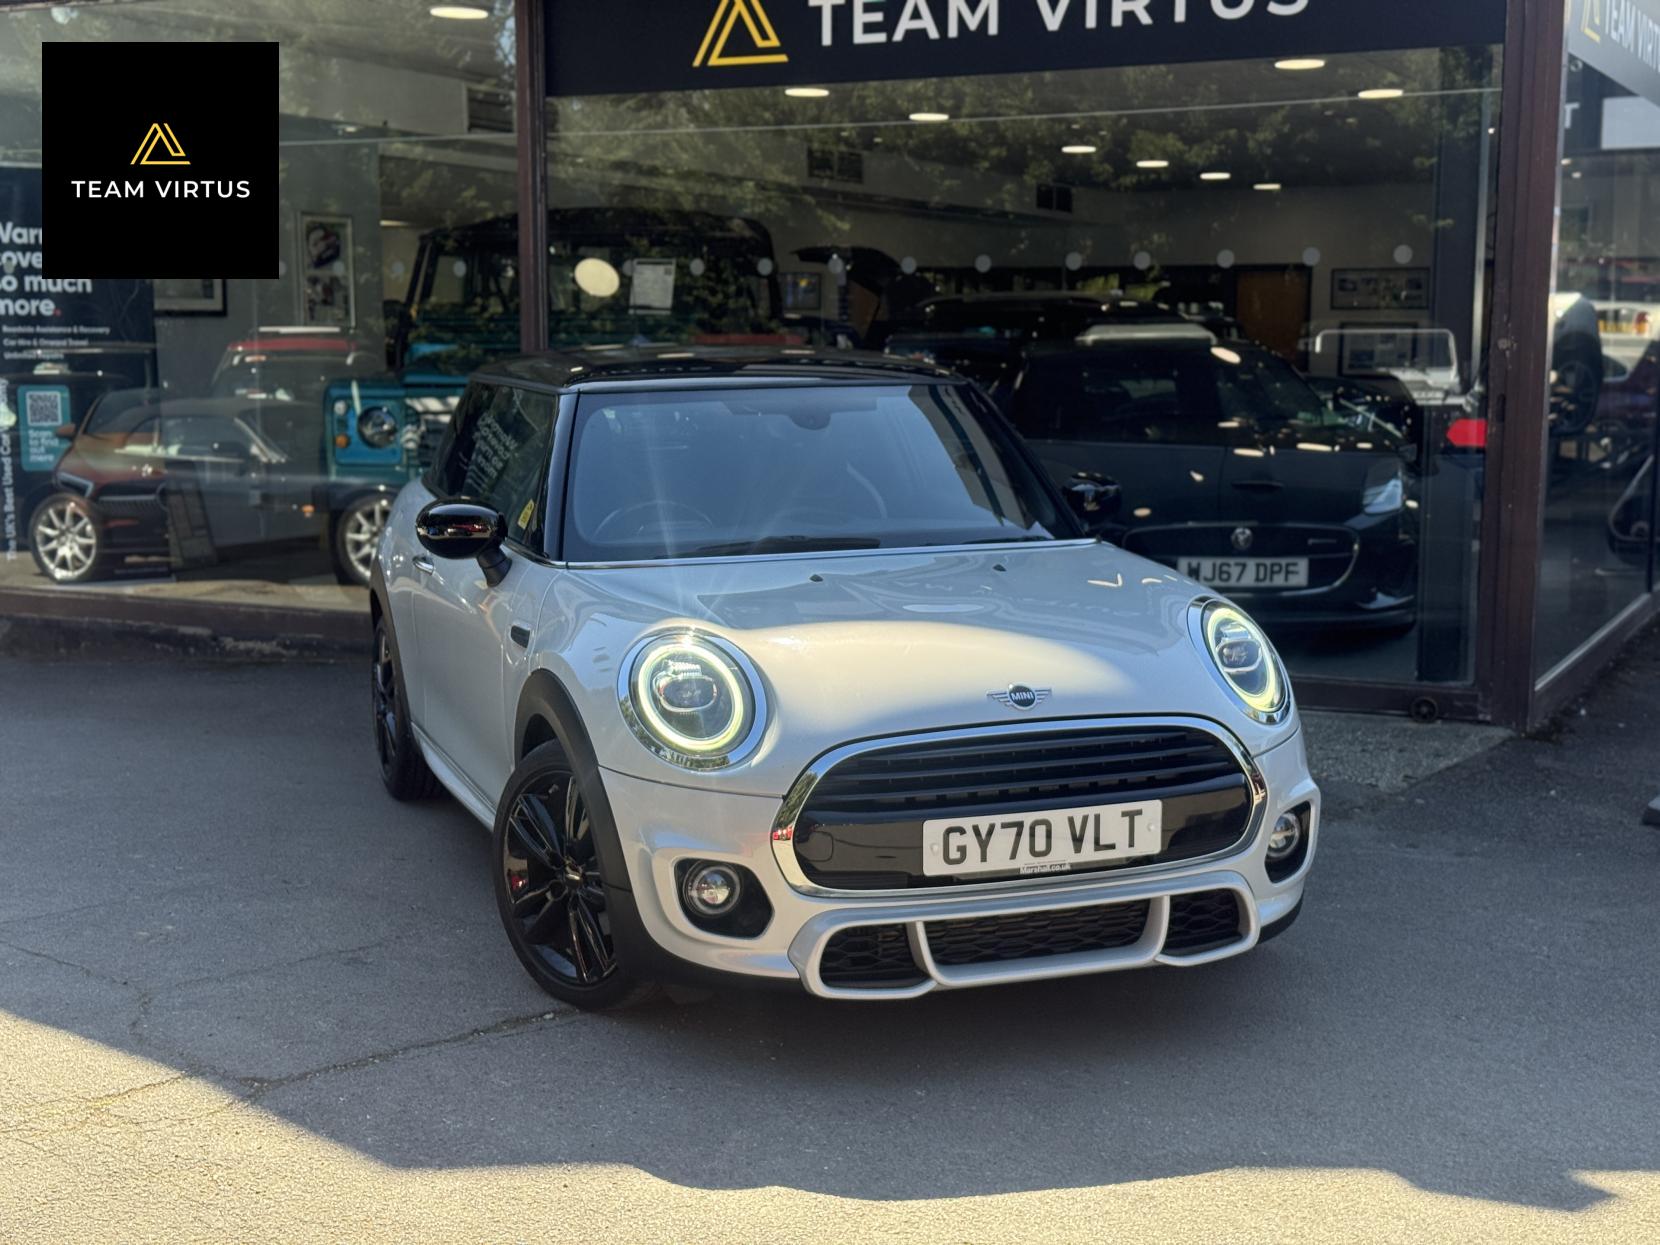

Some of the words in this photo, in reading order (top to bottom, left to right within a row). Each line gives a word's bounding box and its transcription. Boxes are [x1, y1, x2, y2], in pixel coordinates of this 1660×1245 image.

[808, 0, 999, 47] TEAM
[0, 432, 11, 455] Car
[1, 456, 13, 485] Used
[3, 486, 15, 512] Best
[1186, 562, 1248, 583] WJ67
[1254, 562, 1299, 584] DPF
[1010, 691, 1035, 701] MINI
[942, 818, 1053, 866] GY70
[1067, 808, 1143, 855] VLT
